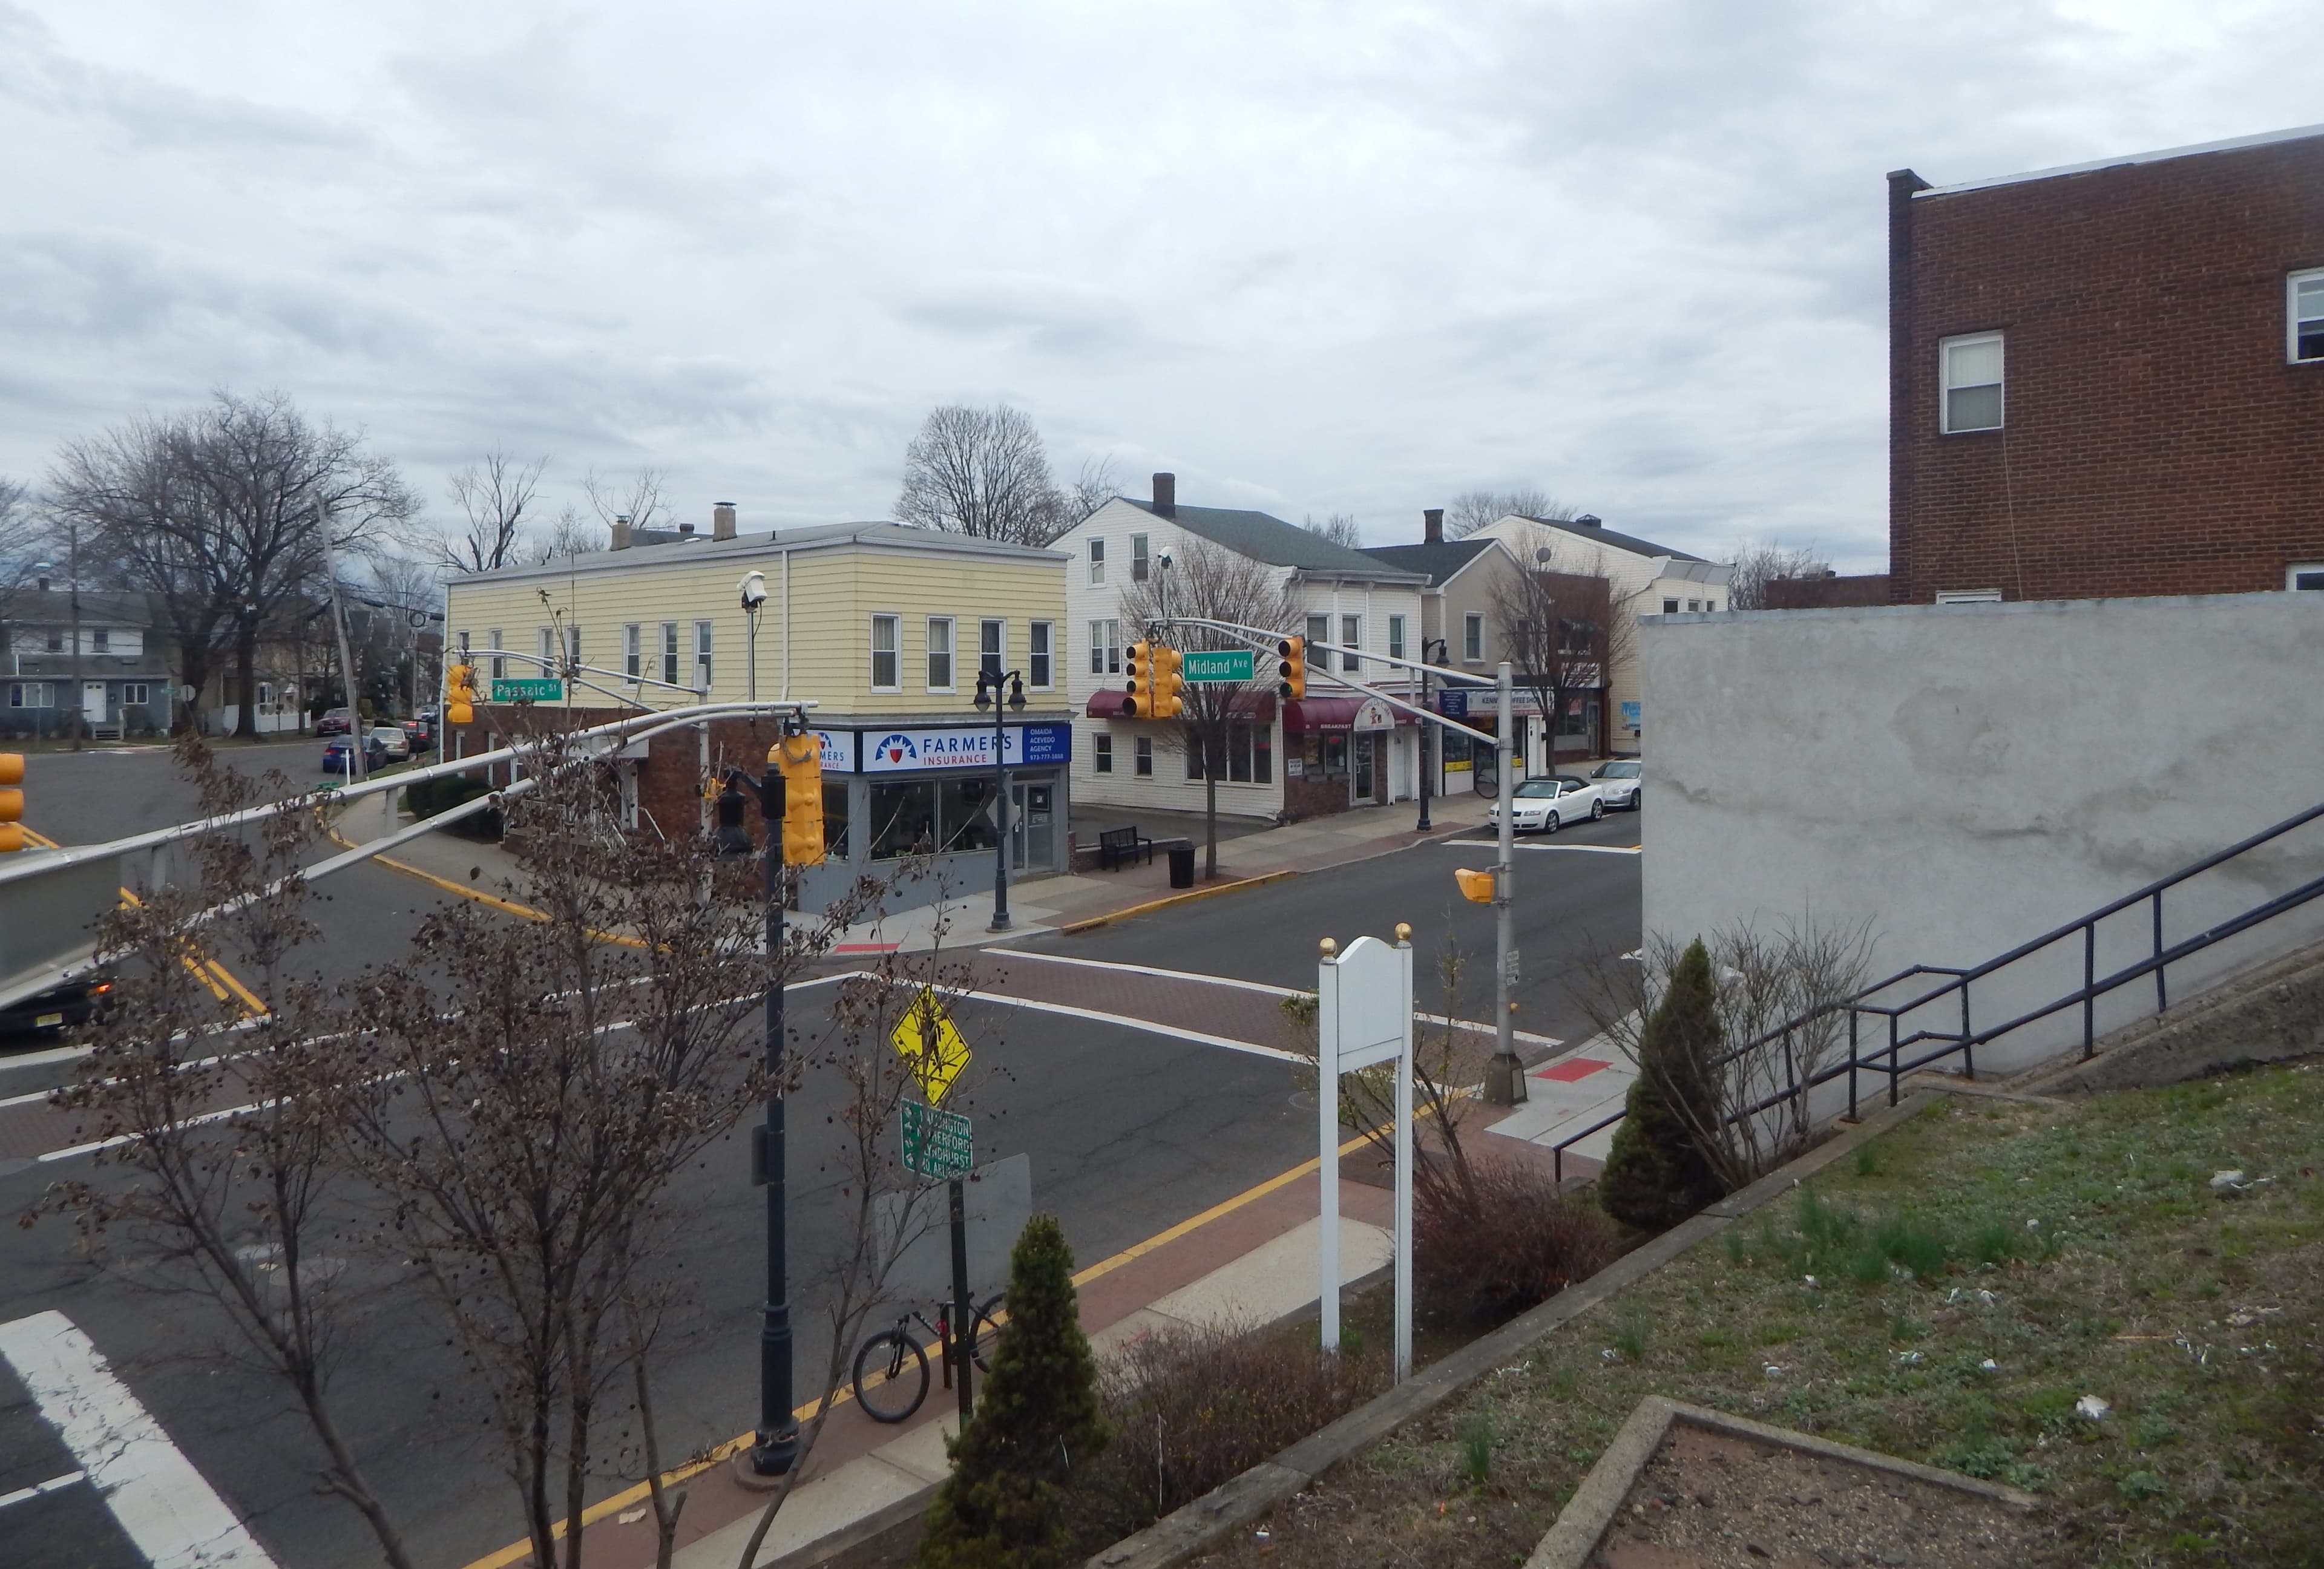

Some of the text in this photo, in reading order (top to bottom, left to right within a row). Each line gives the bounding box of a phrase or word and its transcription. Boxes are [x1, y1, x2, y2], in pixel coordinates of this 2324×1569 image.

[1189, 658, 1248, 675] Midland Ave
[497, 684, 545, 697] Passaic
[924, 735, 1012, 753] FARMERS
[819, 751, 844, 761] MERS
[924, 754, 987, 765] INSURANCE
